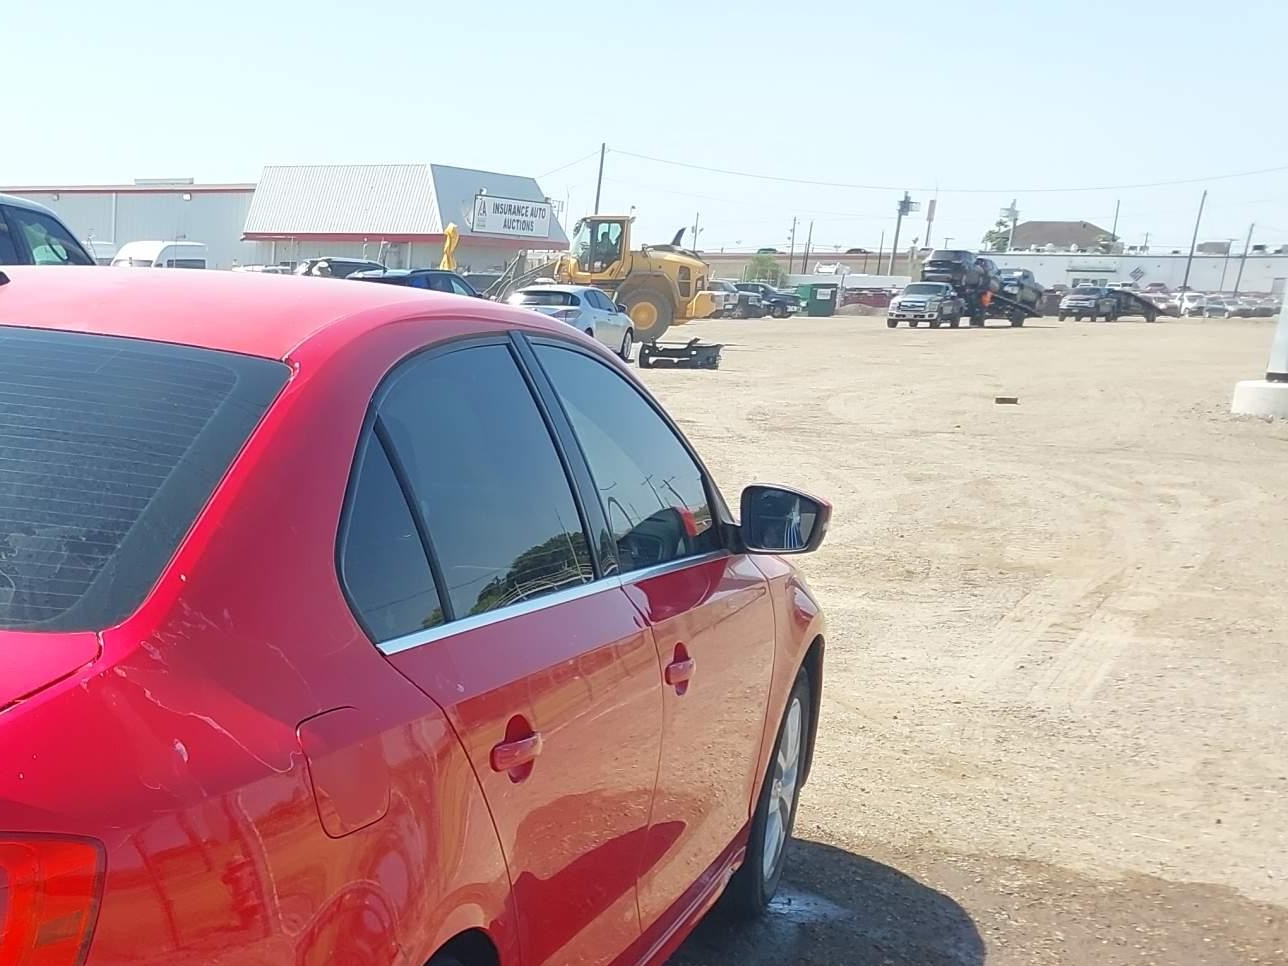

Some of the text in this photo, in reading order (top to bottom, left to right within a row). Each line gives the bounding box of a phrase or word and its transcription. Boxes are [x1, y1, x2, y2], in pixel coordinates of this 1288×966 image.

[492, 202, 546, 219] INSURANCE AUTO
[503, 217, 535, 232] AUCTIONS
